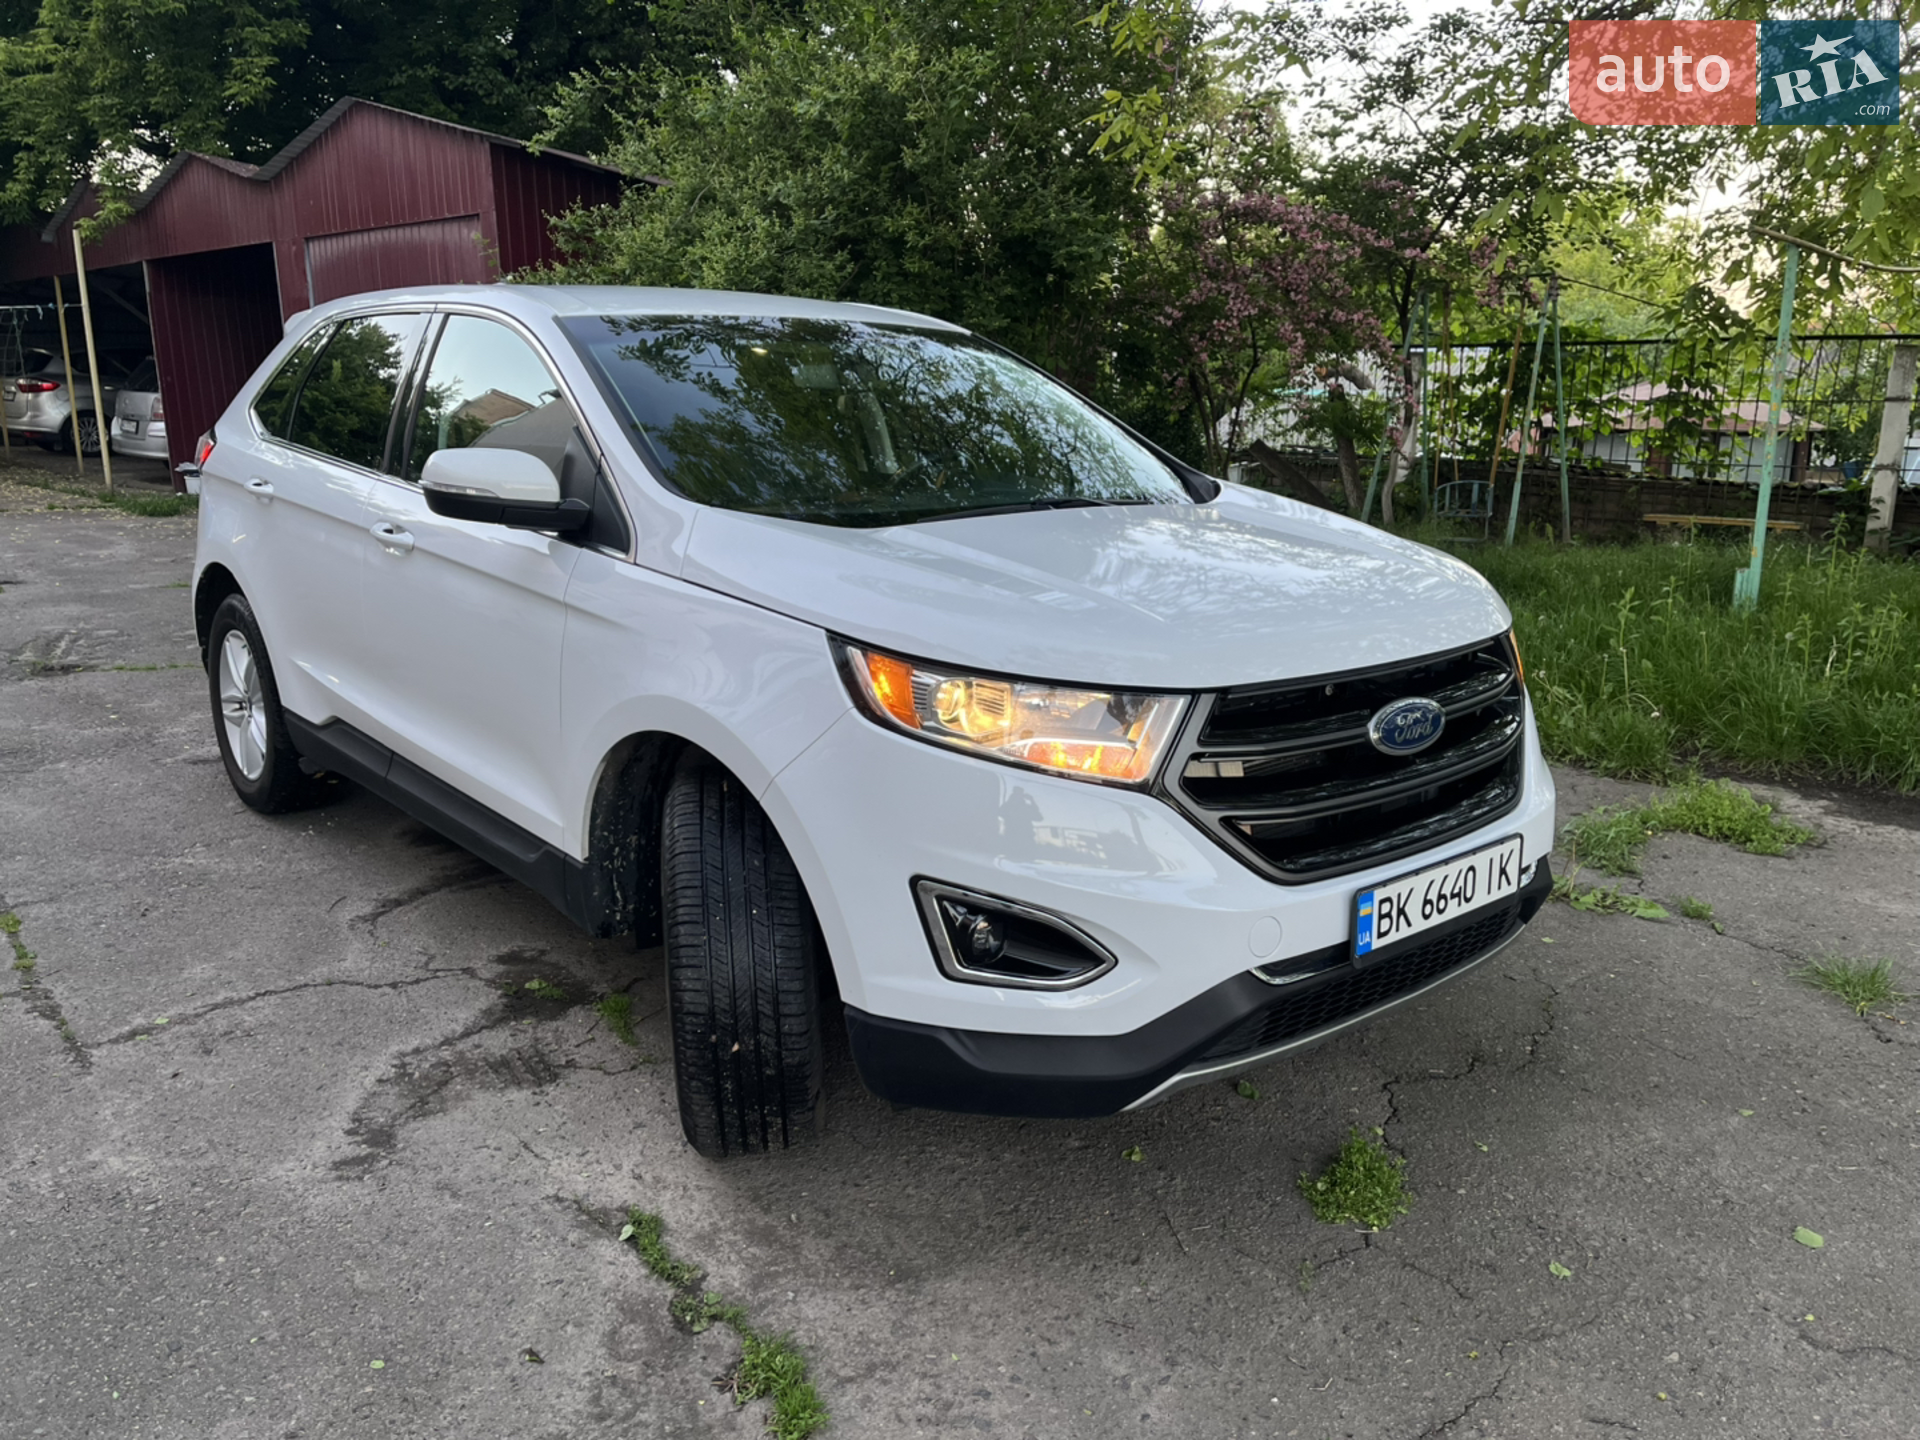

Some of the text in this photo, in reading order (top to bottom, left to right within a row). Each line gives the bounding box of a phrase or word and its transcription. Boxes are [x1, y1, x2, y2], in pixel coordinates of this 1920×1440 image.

[1395, 710, 1434, 743] Ford
[1377, 848, 1515, 940] BK 6640 IK
[1358, 931, 1371, 946] UA
